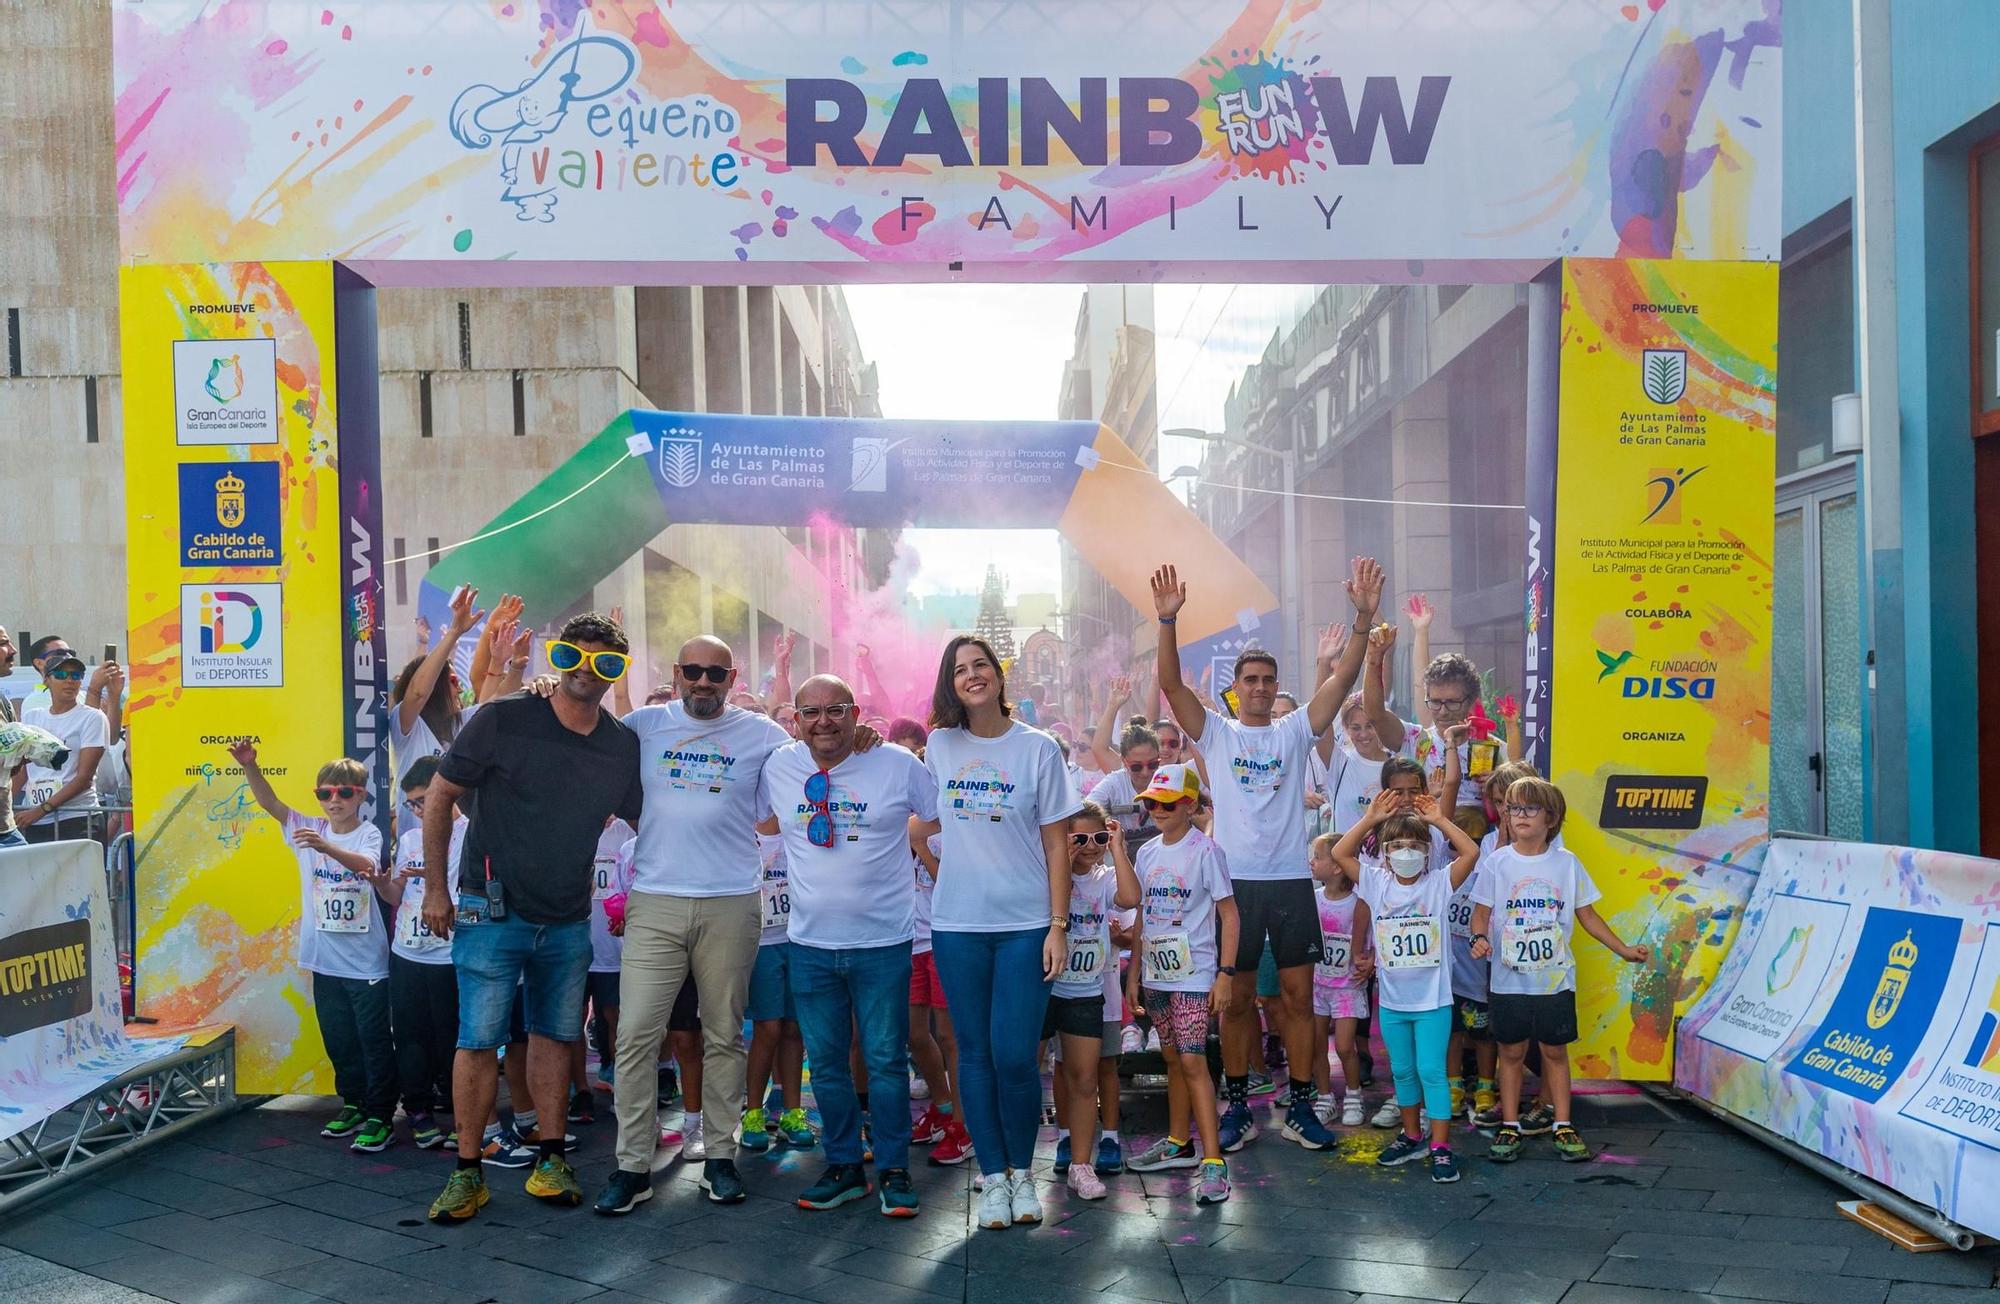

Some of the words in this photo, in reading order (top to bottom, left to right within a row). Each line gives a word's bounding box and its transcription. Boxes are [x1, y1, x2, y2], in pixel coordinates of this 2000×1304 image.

[1217, 80, 1295, 120] FUN
[1218, 109, 1304, 156] RUN
[532, 147, 739, 190] valiente
[900, 195, 1344, 231] FAMILY
[189, 303, 256, 315] PROMUEVE
[1632, 303, 1699, 314] PROMUEVE
[1620, 411, 1706, 423] Ayuntamiento
[1620, 423, 1634, 433] de
[1641, 424, 1660, 433] Las
[1666, 424, 1706, 435] Palmas
[1620, 434, 1633, 444] de
[1636, 435, 1662, 445] Gran
[1665, 436, 1706, 446] Canaria
[711, 442, 826, 458] Ayuntamiento
[1019, 449, 1066, 458] Promoción
[711, 456, 730, 469] de
[739, 458, 763, 471] Las
[772, 459, 825, 473] Palmas
[1014, 460, 1051, 471] Deporte
[1053, 460, 1065, 470] de
[711, 472, 729, 485] de
[732, 473, 767, 486] Gran
[771, 475, 825, 488] Canaria
[193, 533, 245, 546] Cabildo
[248, 533, 265, 546] de
[1580, 538, 1617, 547] Instituto
[1619, 538, 1663, 550] Municipal
[1664, 541, 1686, 551] para
[1687, 539, 1696, 548] la
[1698, 540, 1745, 549] Promoción
[187, 547, 220, 559] Gran
[223, 546, 275, 559] Canaria
[1581, 550, 1594, 559] de
[1595, 550, 1604, 559] la
[1605, 550, 1648, 560] Actividad
[1675, 553, 1682, 562] y
[1683, 551, 1692, 560] el
[1693, 551, 1730, 562] Deporte
[1732, 552, 1745, 561] de
[1592, 564, 1609, 573] Las
[1611, 563, 1647, 574] Palmas
[1649, 564, 1663, 574] de
[1665, 564, 1690, 574] Gran
[1693, 564, 1732, 575] Canaria
[1625, 608, 1693, 619] COLABORA
[1650, 659, 1718, 672] FUNDACIÓN
[209, 668, 269, 680] DEPORTES
[1622, 731, 1686, 742] ORGANIZA
[662, 750, 736, 766] RAINBOW
[259, 766, 288, 776] ncer
[946, 780, 1015, 793] RAINBOW
[31, 788, 54, 804] 302
[1615, 788, 1696, 809] TOPTIME
[797, 802, 868, 813] RAIBOW
[323, 899, 355, 921] 193
[1392, 933, 1428, 957] 310
[1516, 938, 1553, 962] 208
[1823, 1029, 1872, 1060] Cabildo
[1872, 1044, 1893, 1067] de
[1802, 1047, 1835, 1072] Gran
[1833, 1057, 1888, 1091] Canaria
